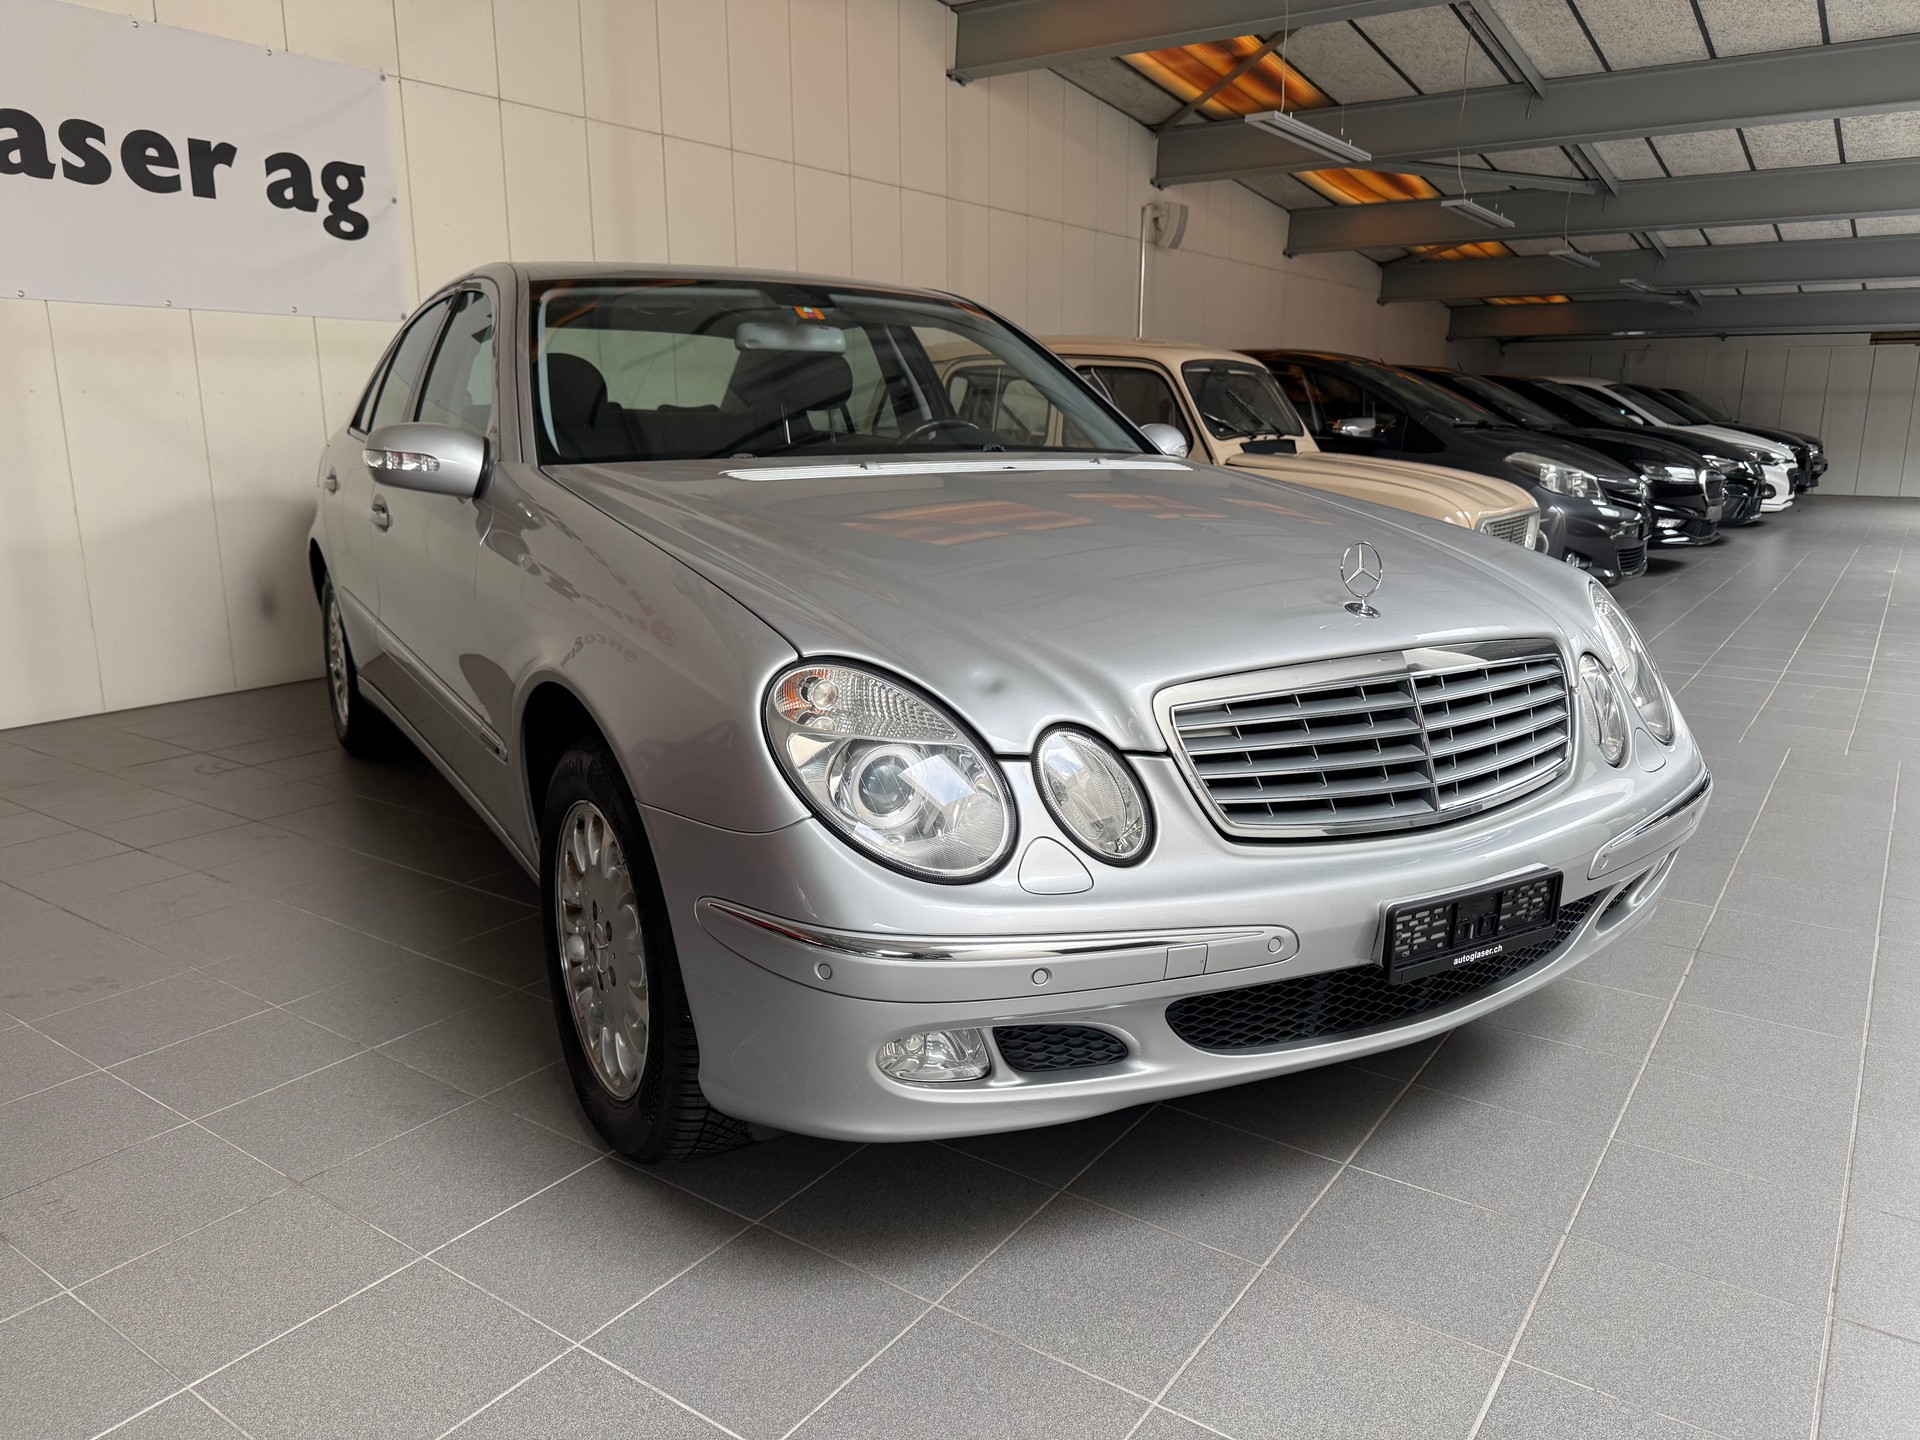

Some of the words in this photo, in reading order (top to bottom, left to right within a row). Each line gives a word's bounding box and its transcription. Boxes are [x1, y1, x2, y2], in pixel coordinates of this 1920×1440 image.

[0, 108, 237, 199] aser
[265, 152, 369, 240] ag
[1453, 944, 1503, 965] autoglaser.ch
